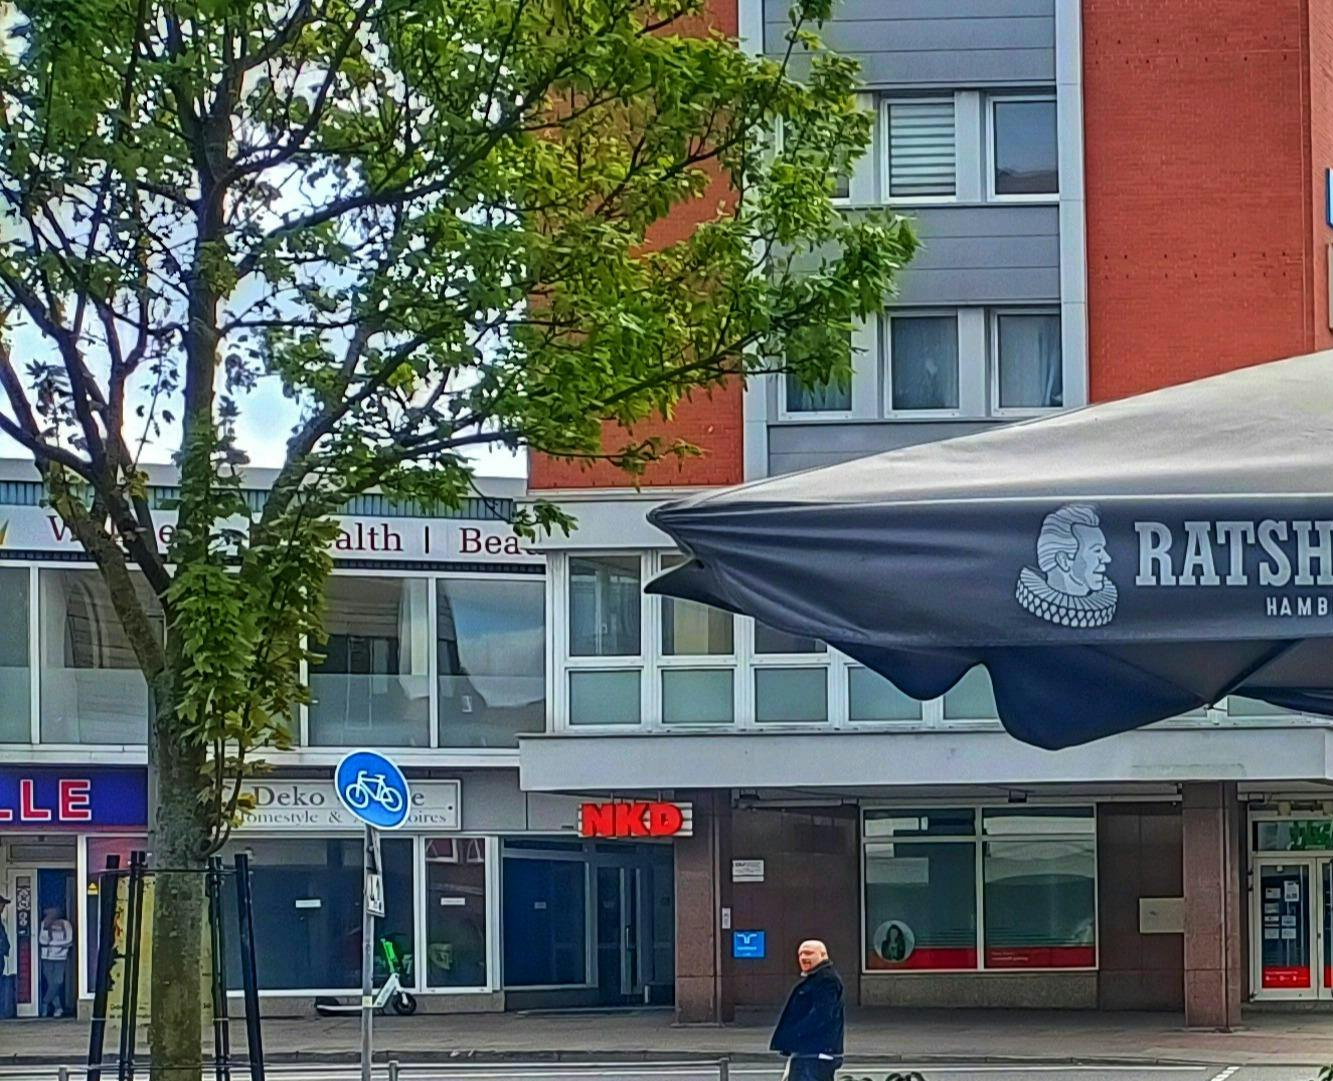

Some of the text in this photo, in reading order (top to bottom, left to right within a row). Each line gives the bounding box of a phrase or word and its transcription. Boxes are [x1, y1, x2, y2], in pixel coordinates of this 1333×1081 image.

[326, 522, 404, 552] alth
[0, 779, 92, 821] LE
[252, 785, 325, 807] Deko
[329, 811, 342, 824] &
[581, 802, 684, 837] NKD
